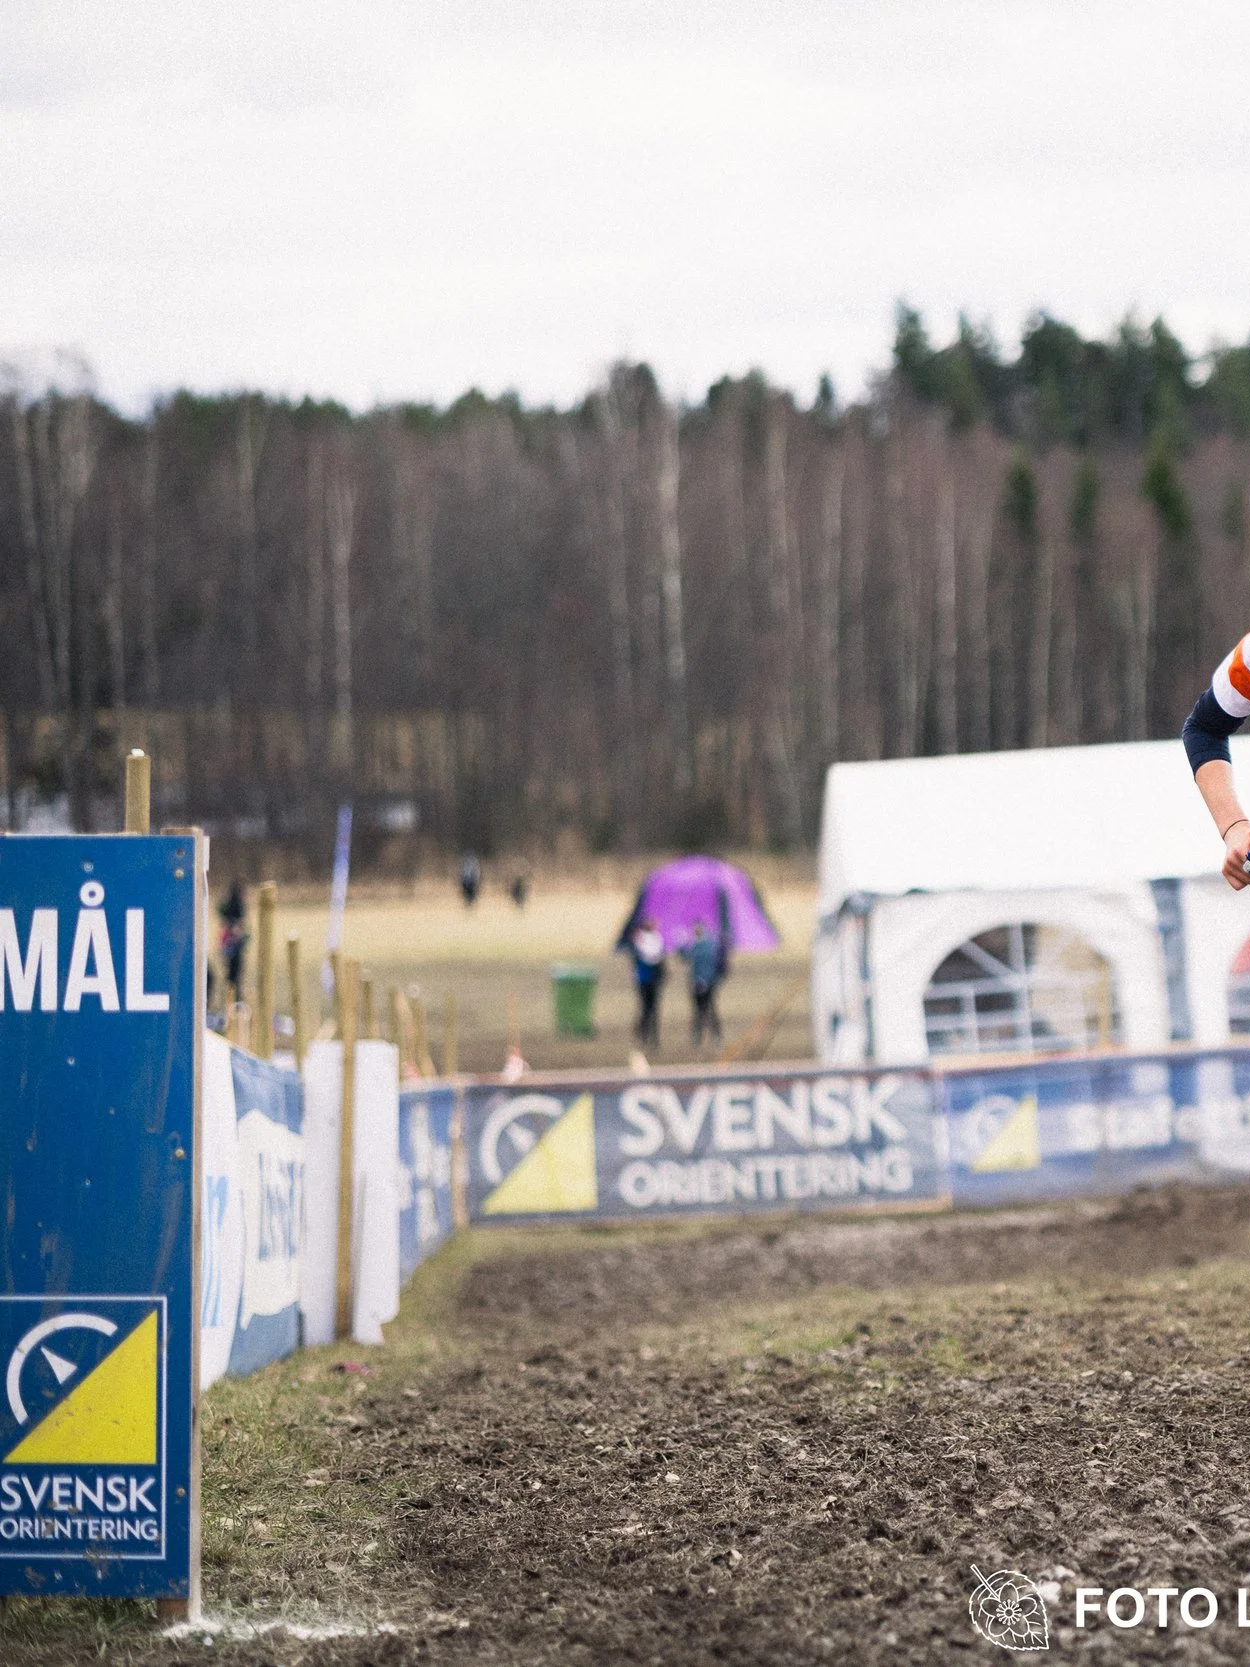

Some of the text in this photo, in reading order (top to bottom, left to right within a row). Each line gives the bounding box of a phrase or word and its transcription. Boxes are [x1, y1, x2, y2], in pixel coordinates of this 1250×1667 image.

[0, 881, 170, 1012] MÅL
[619, 1075, 908, 1157] SVENSK
[619, 1146, 914, 1208] ORIENTERING
[0, 1475, 158, 1513] SVENSK
[0, 1517, 159, 1541] ORIENTERING
